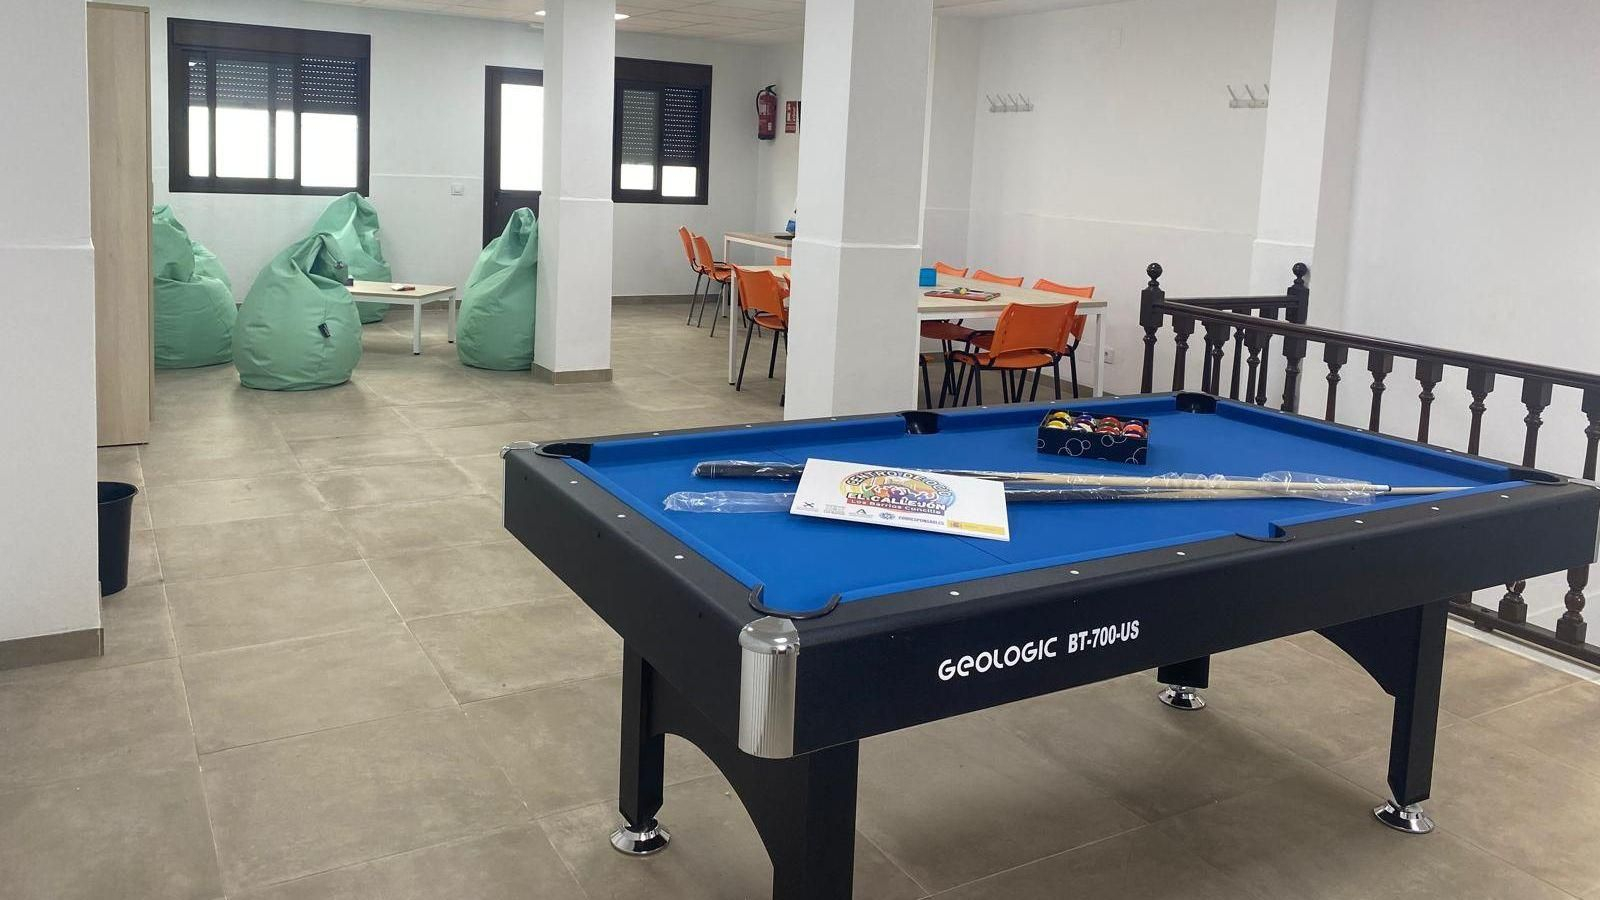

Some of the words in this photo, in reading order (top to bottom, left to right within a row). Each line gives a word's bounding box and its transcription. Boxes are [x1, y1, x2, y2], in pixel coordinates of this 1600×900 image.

[846, 492, 865, 500] EL
[869, 495, 948, 511] CALLEJÓN
[1067, 619, 1140, 654] BT-700-US
